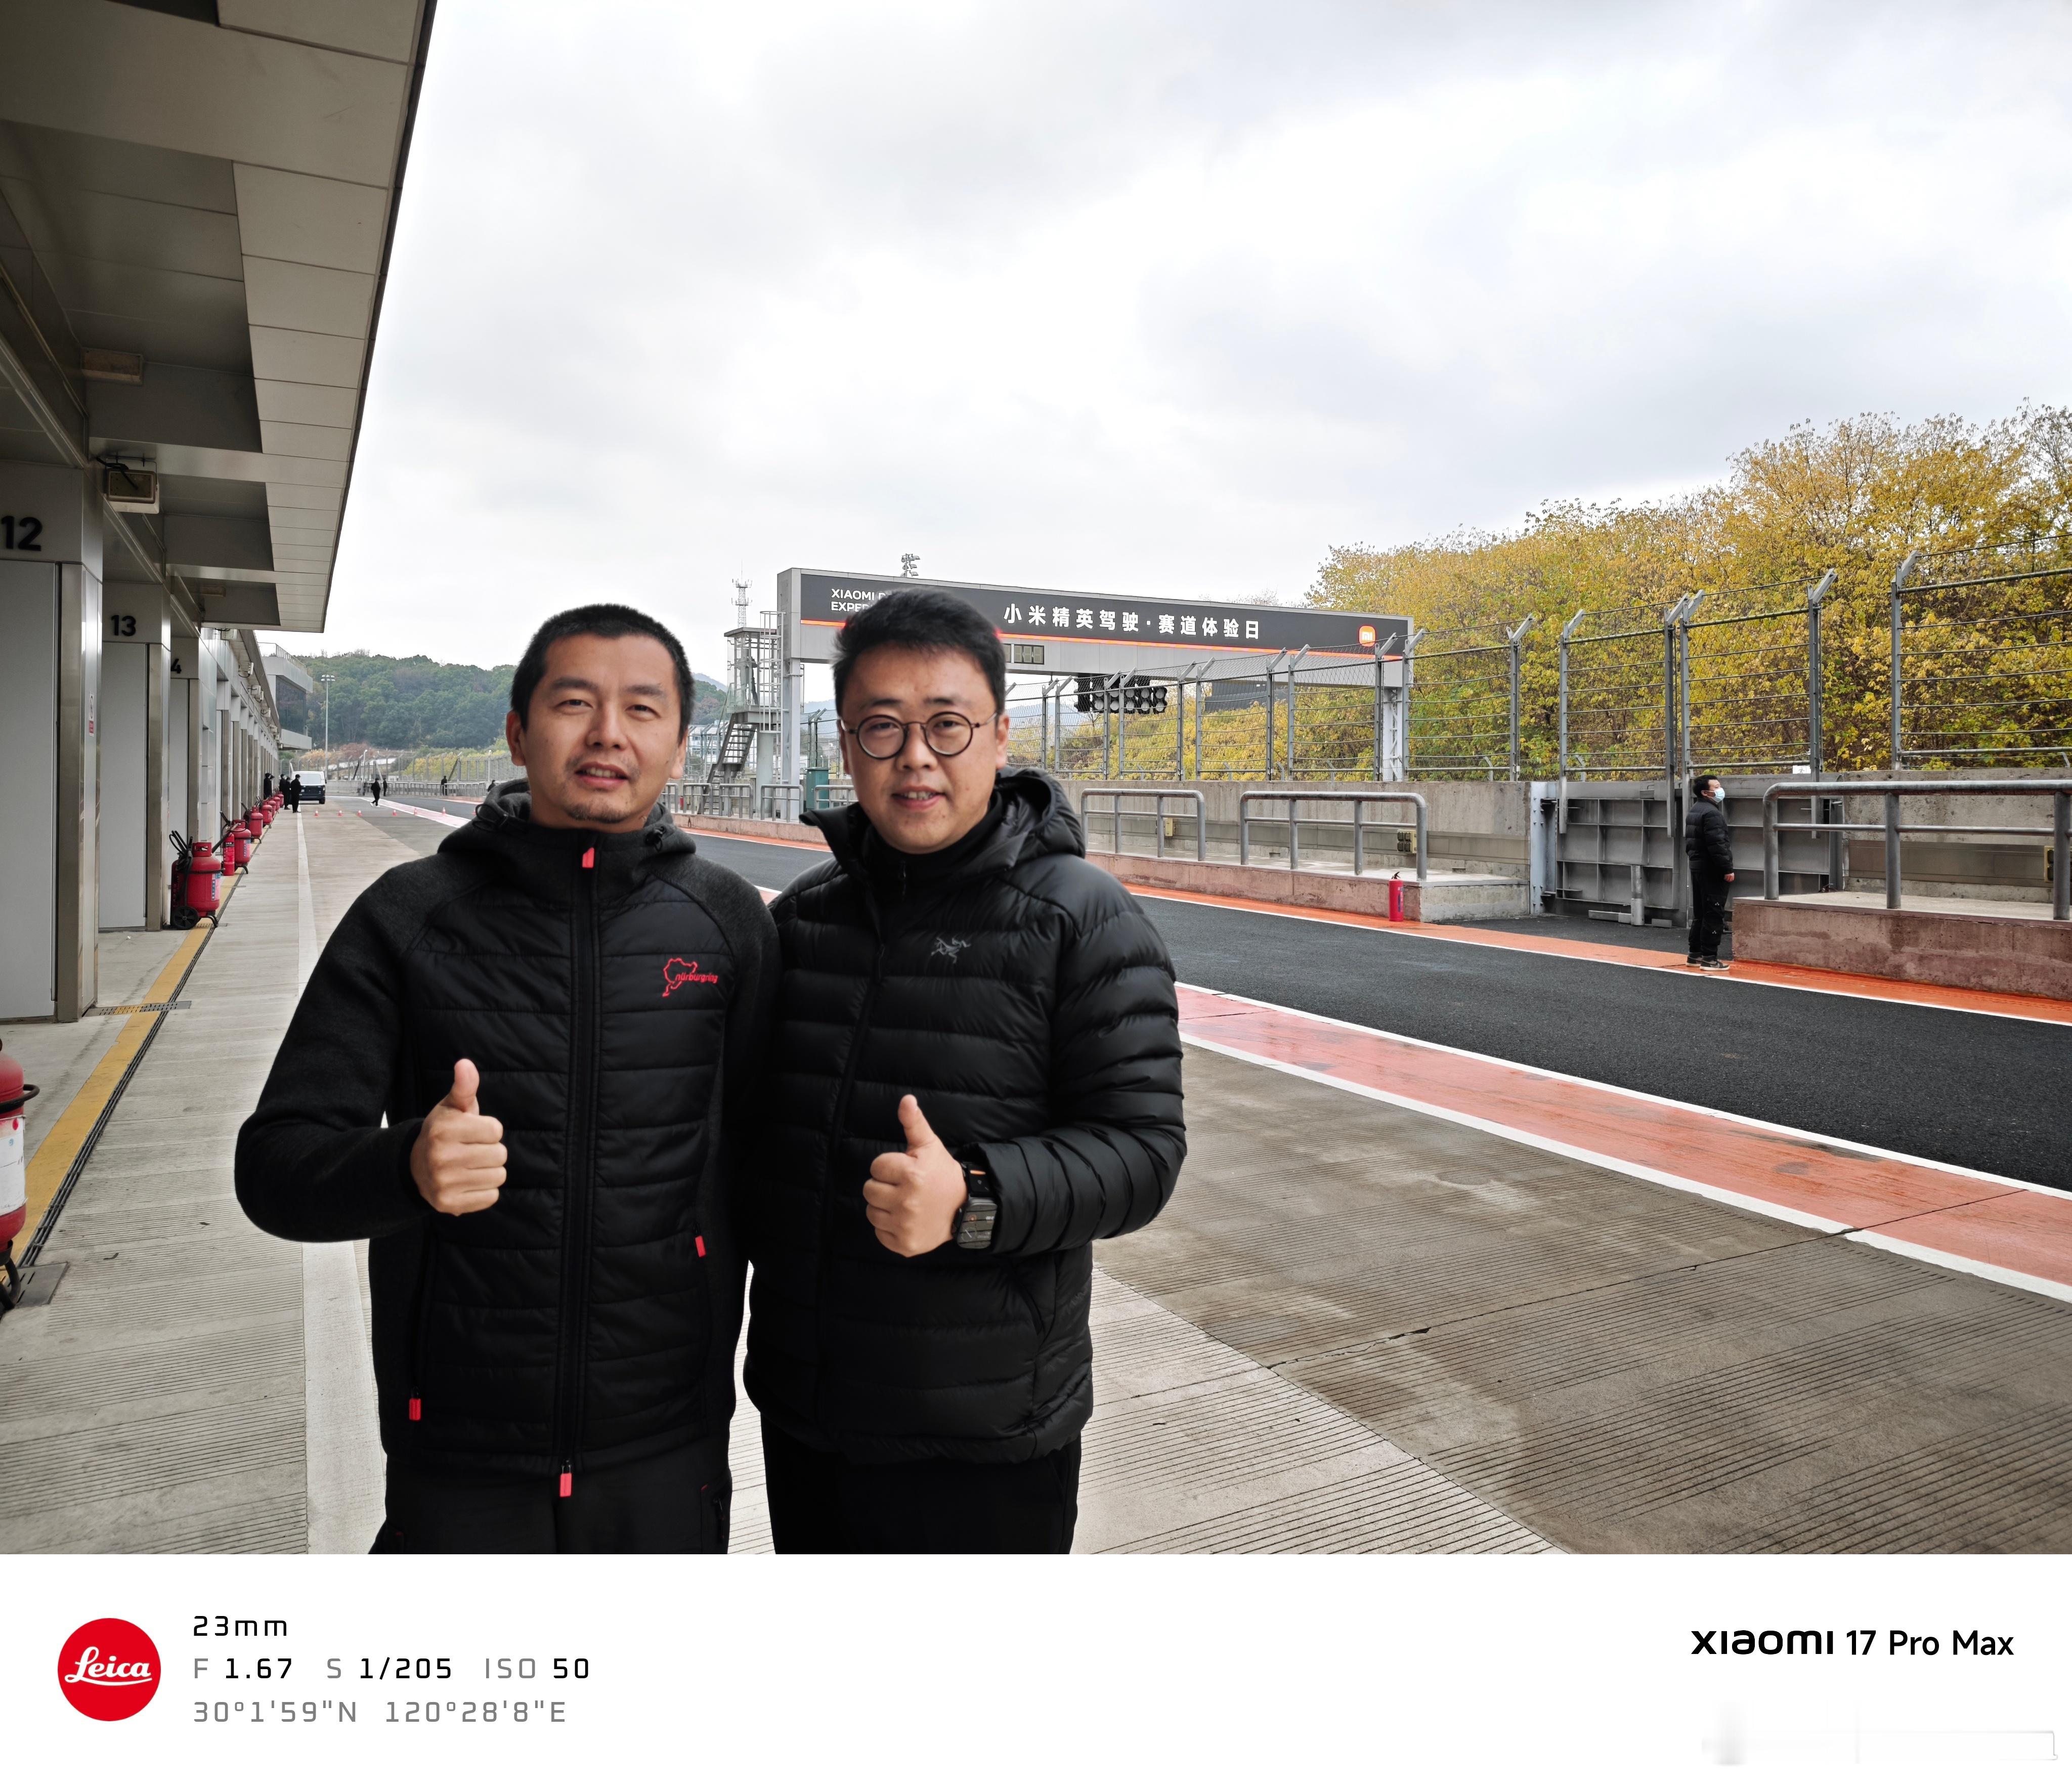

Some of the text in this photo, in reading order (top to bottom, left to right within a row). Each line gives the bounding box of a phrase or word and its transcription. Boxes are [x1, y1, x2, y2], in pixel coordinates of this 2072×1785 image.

[1, 516, 42, 551] 12
[831, 588, 875, 601] XIAOMI
[111, 615, 136, 636] 13
[1004, 603, 1259, 640] 小米精英驾驶·赛道体验日
[170, 658, 182, 674] 4
[675, 972, 718, 984] nürburgring
